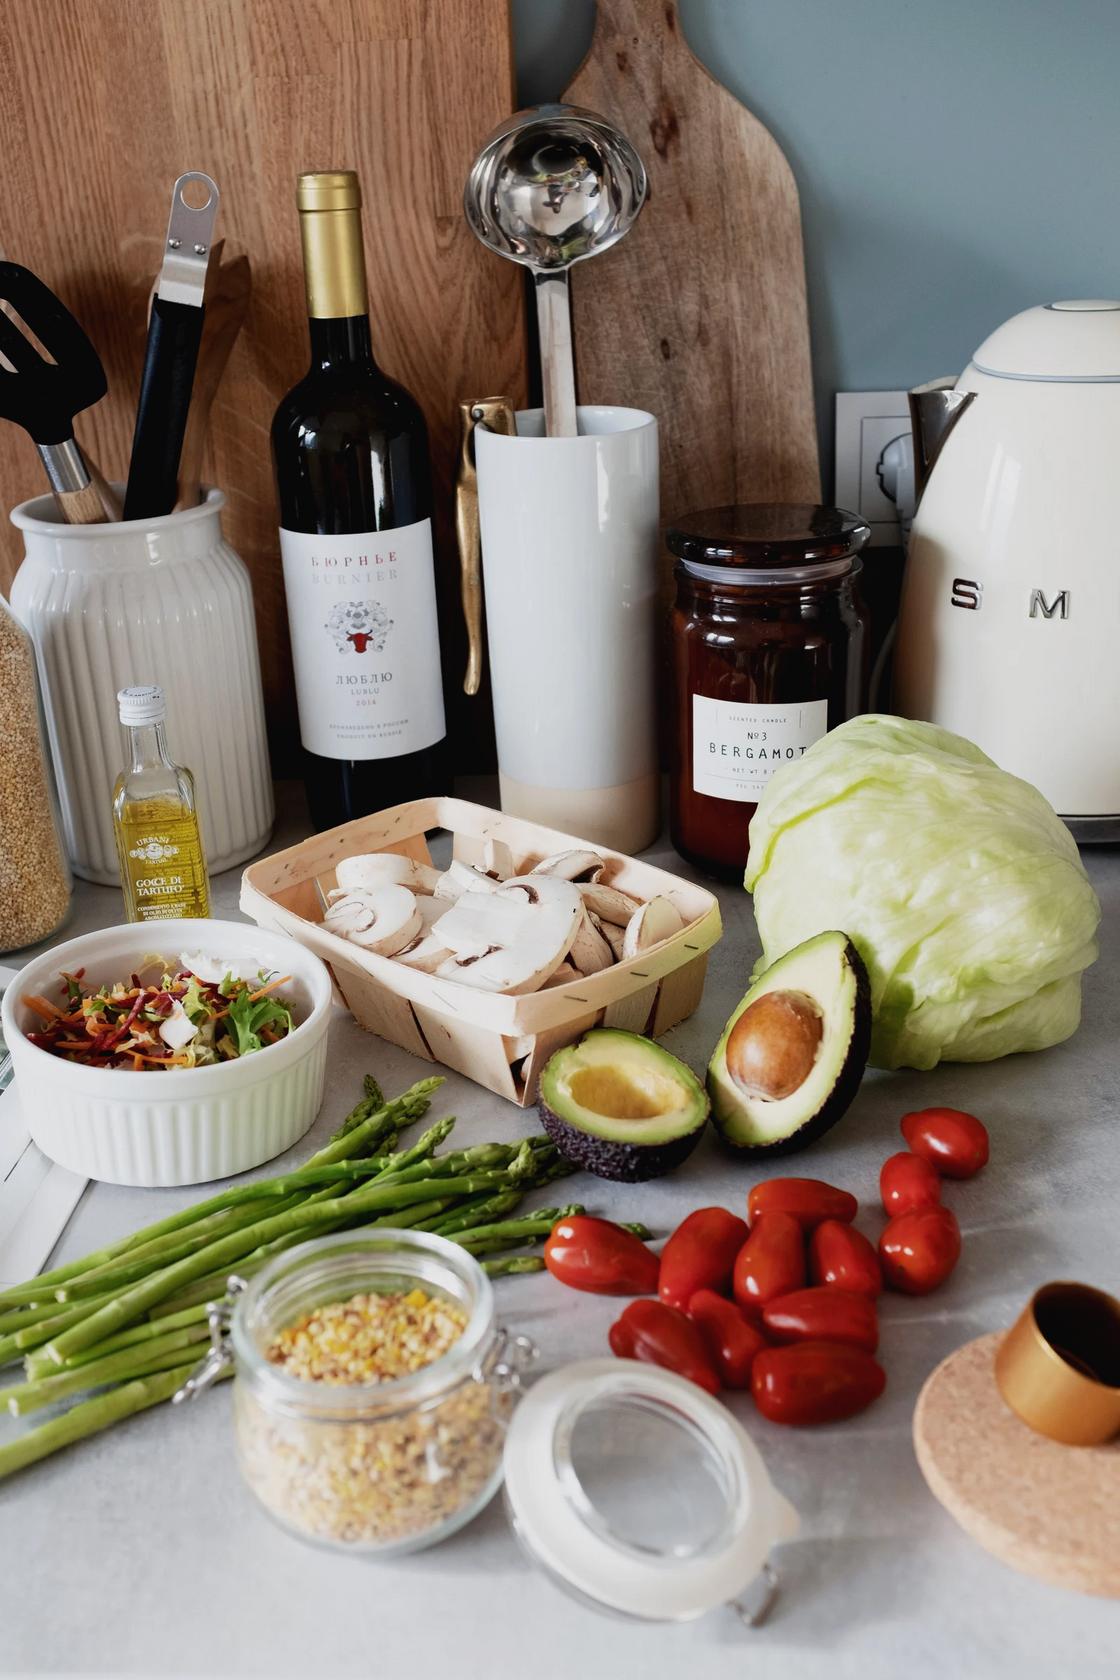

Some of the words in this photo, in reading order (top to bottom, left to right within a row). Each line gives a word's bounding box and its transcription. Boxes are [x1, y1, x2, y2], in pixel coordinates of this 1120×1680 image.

[311, 551, 397, 567] БЮРНЬЕ
[312, 568, 398, 585] BURNIER
[336, 672, 393, 685] ЛЮБЛЮ
[350, 687, 380, 696] LUBLU
[709, 742, 806, 759] BERGAMOT
[136, 836, 169, 846] URBANI
[170, 876, 182, 885] DI
